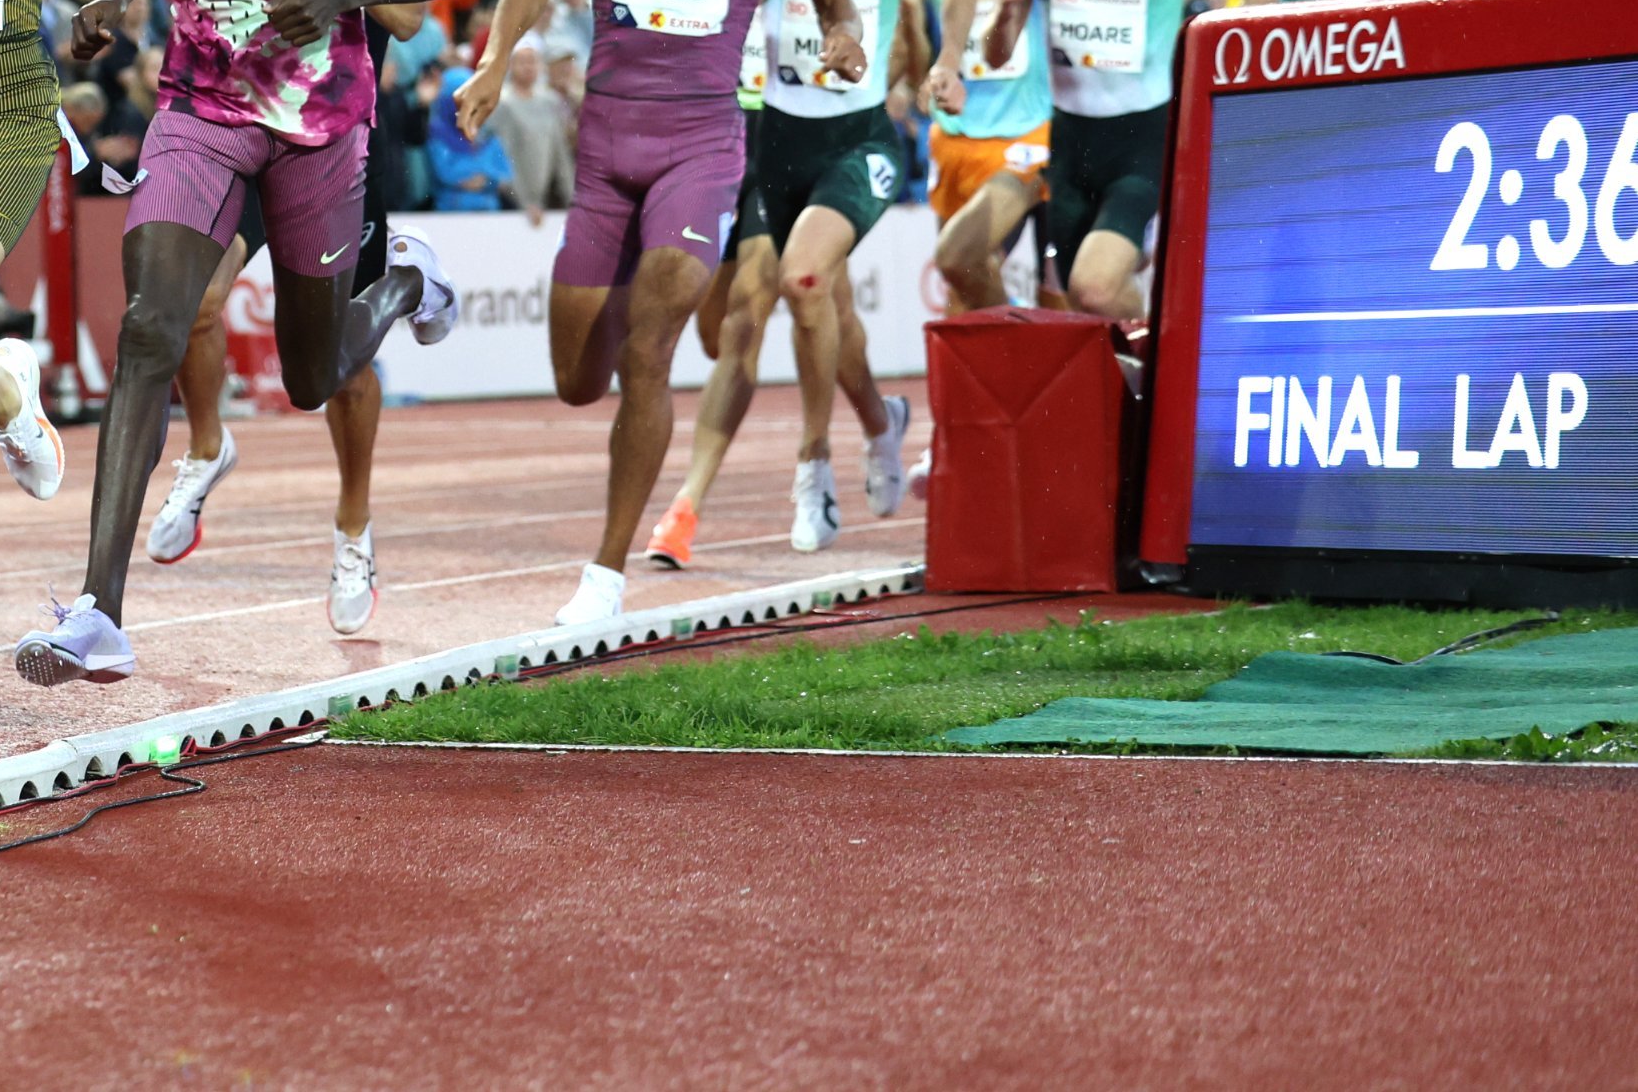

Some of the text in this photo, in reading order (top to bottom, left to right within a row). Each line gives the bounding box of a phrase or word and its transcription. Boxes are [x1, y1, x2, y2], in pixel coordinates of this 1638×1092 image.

[669, 18, 710, 30] EXTRA
[1060, 22, 1132, 44] HOARE
[1260, 16, 1407, 81] OMEGA
[1429, 112, 1638, 272] 2:36
[1234, 371, 1590, 469] FINAL LAP
